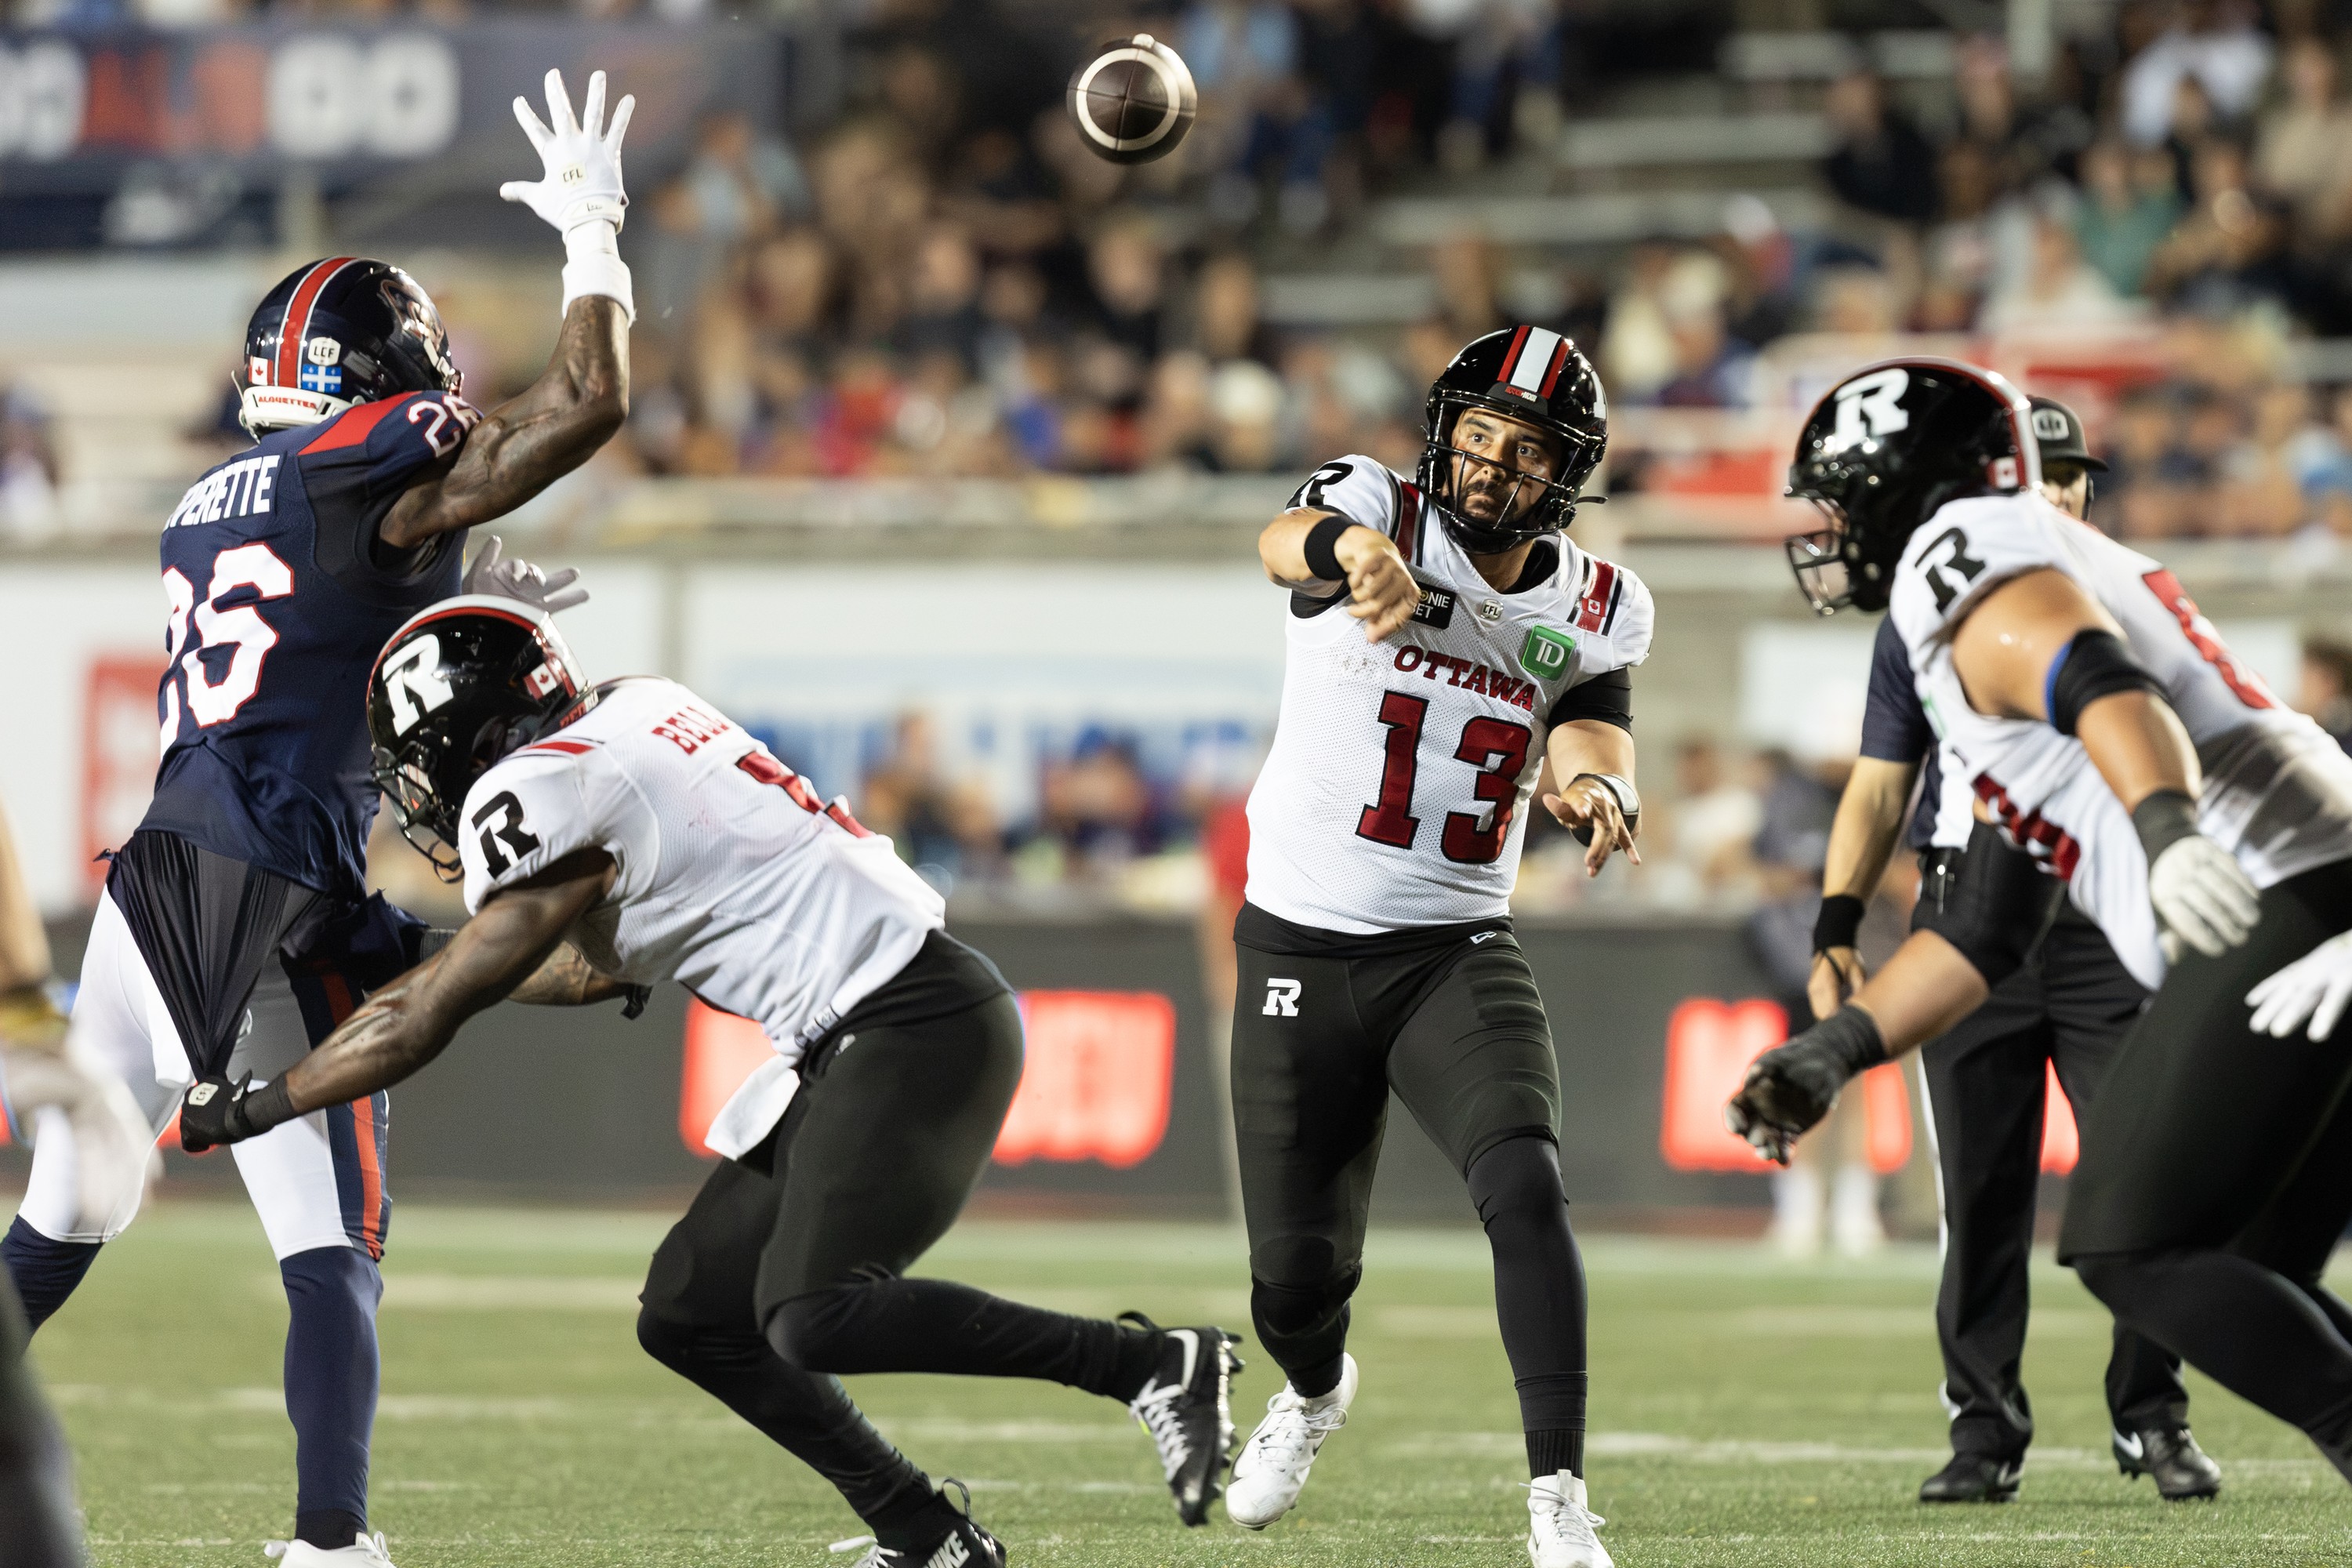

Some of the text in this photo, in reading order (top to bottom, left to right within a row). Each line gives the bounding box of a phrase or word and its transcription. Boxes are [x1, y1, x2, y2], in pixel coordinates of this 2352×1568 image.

[562, 169, 583, 183] CFL
[314, 346, 335, 358] LCF
[1835, 368, 1909, 447] R
[162, 455, 281, 532] PERETTE
[1421, 590, 1450, 608] ONIE
[1915, 528, 1986, 613] R
[1483, 604, 1498, 616] CFL
[383, 633, 454, 737] R
[1394, 644, 1537, 712] OTTAWA
[1534, 635, 1566, 667] TD
[1356, 690, 1532, 862] 13
[471, 792, 541, 880] R
[1262, 978, 1301, 1017] R
